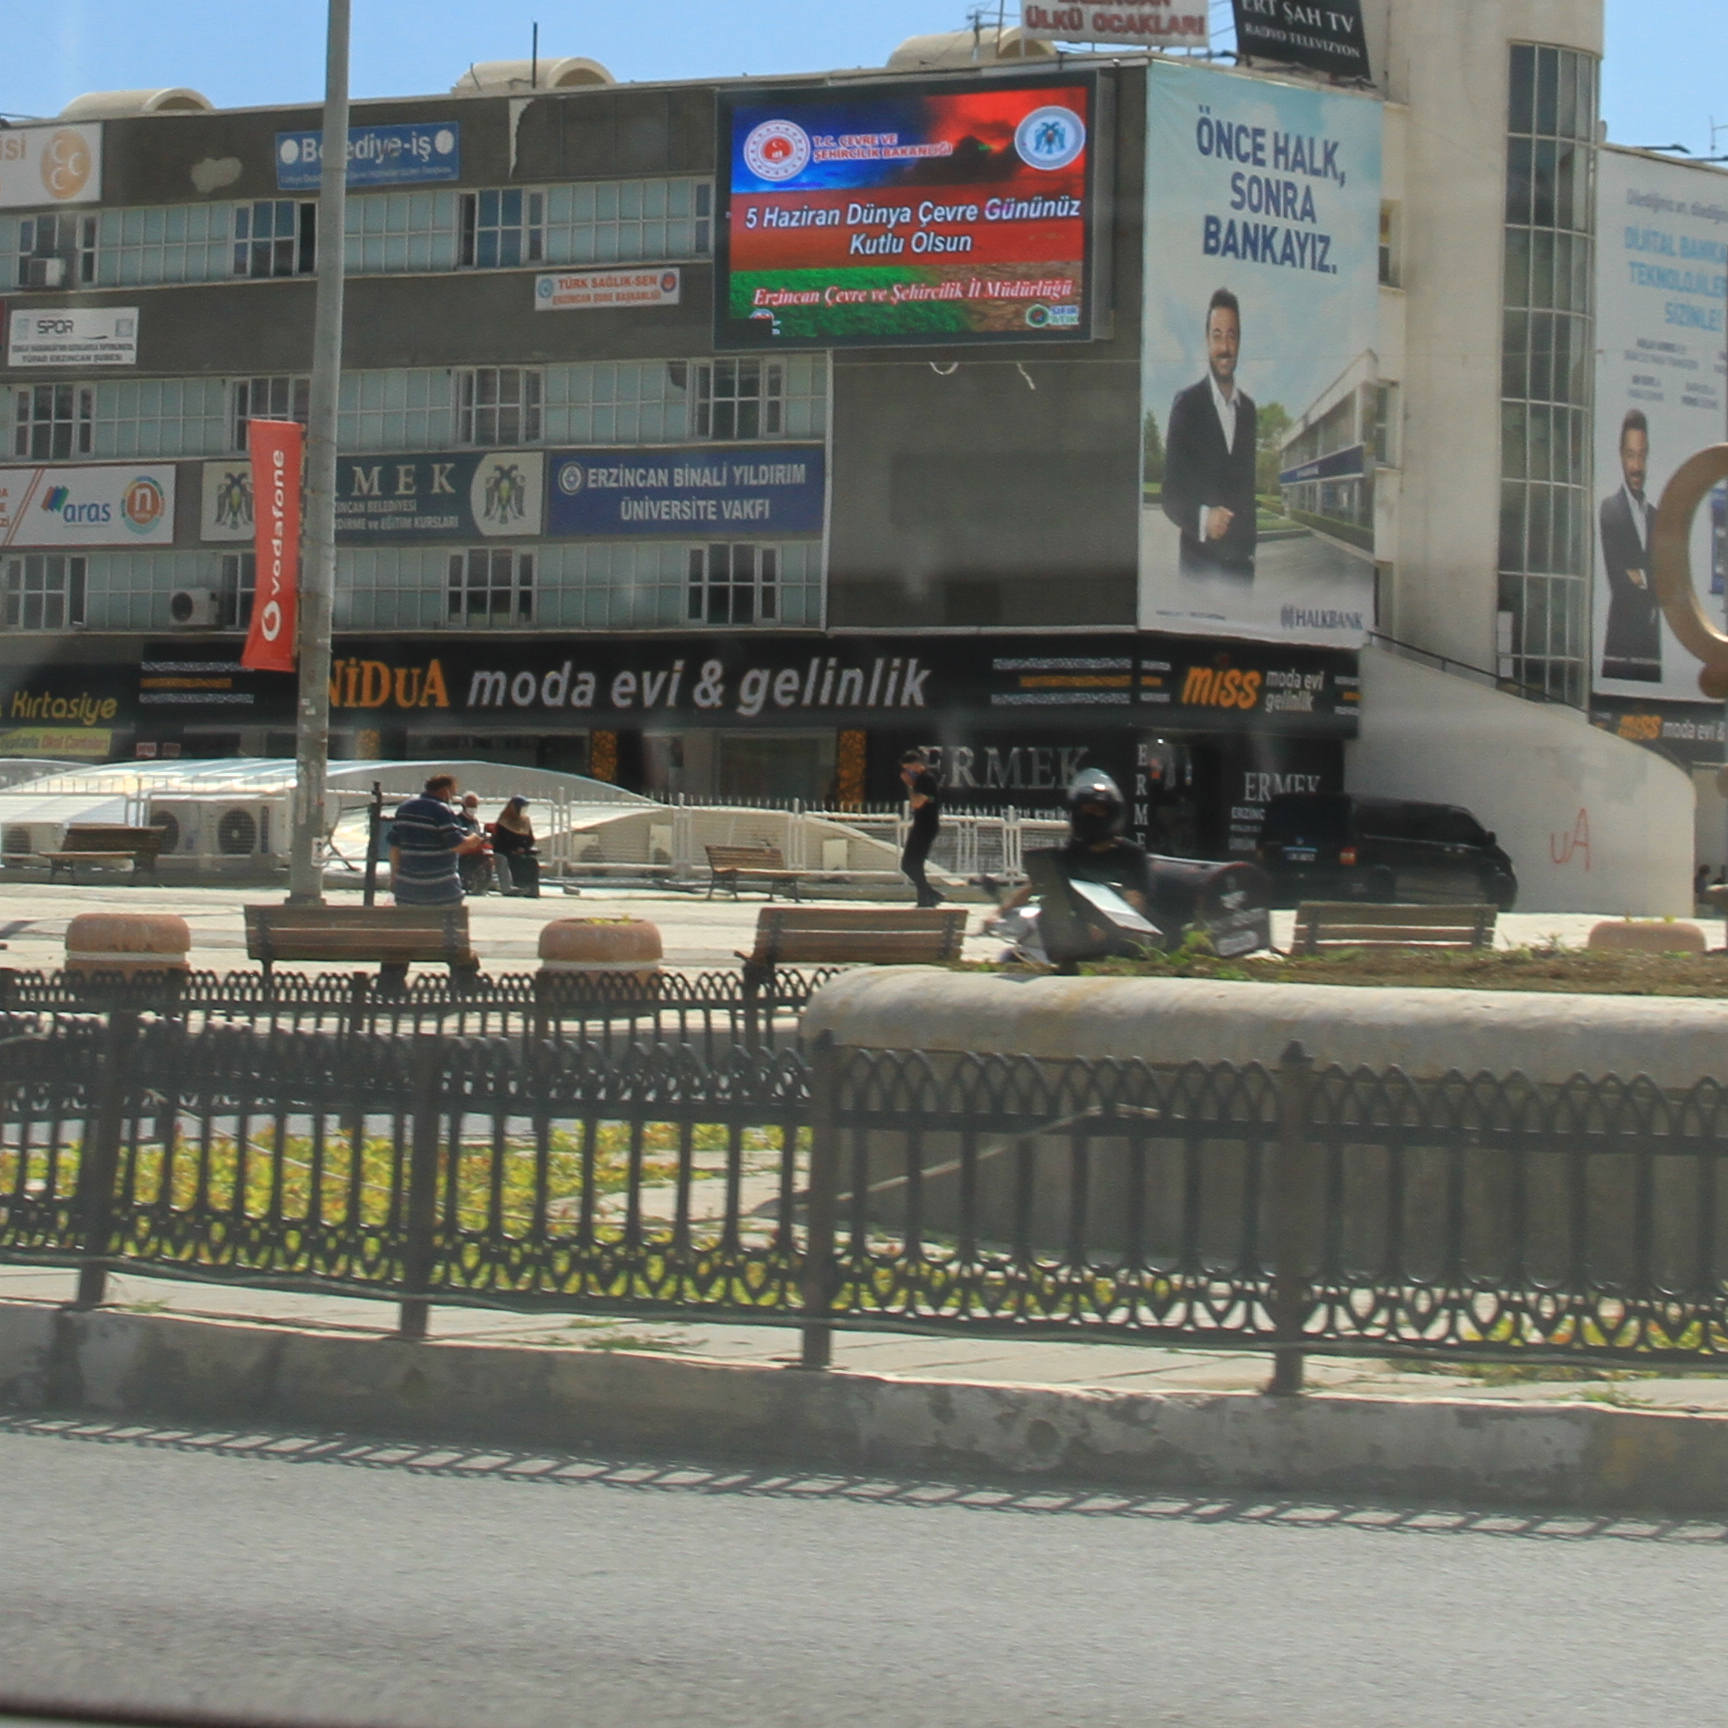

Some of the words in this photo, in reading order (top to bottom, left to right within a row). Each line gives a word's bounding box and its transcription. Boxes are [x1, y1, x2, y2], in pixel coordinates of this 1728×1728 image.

[1026, 5, 1083, 31] ÜLKÜ
[1327, 11, 1354, 33] TV
[880, 134, 897, 145] VE
[1197, 106, 1266, 168] ÖNCE
[1272, 131, 1345, 187] HALK,
[1231, 171, 1316, 223] SONRA
[745, 208, 758, 228] 5
[763, 205, 840, 228] Haziran
[847, 200, 912, 229] Dünya
[918, 200, 978, 227] Çevre
[984, 196, 1081, 221] Gününüz
[850, 232, 905, 255] Kutlu
[911, 231, 972, 253] Olsun
[1203, 215, 1337, 273] BANKAYIZ.
[559, 277, 588, 289] TÜRK
[753, 287, 819, 306] Erzincan
[824, 286, 867, 306] Çevre
[872, 289, 887, 301] ve
[889, 283, 962, 304] Şehircilik
[968, 277, 979, 298] İl
[984, 279, 1073, 300] Müdürlüğü
[37, 320, 74, 334] SPOR
[587, 463, 668, 489] ERZİNCAN
[674, 462, 727, 487] BİNALİ
[733, 464, 806, 485] YILDIRIM
[63, 502, 111, 523] aras
[622, 495, 717, 520] ÜNİVERSİTE
[722, 499, 770, 520] VAKFI
[270, 449, 284, 596] vodafone
[1296, 610, 1363, 630] HALKBANK
[467, 658, 593, 707] moda
[611, 657, 684, 707] evi
[693, 659, 725, 708] &
[736, 656, 932, 717] gelinlik
[1182, 666, 1262, 709] miss
[1266, 669, 1301, 688] moda
[1304, 671, 1324, 690] evi
[12, 690, 118, 726] Kırtasiye
[1265, 690, 1314, 712] gelinlik
